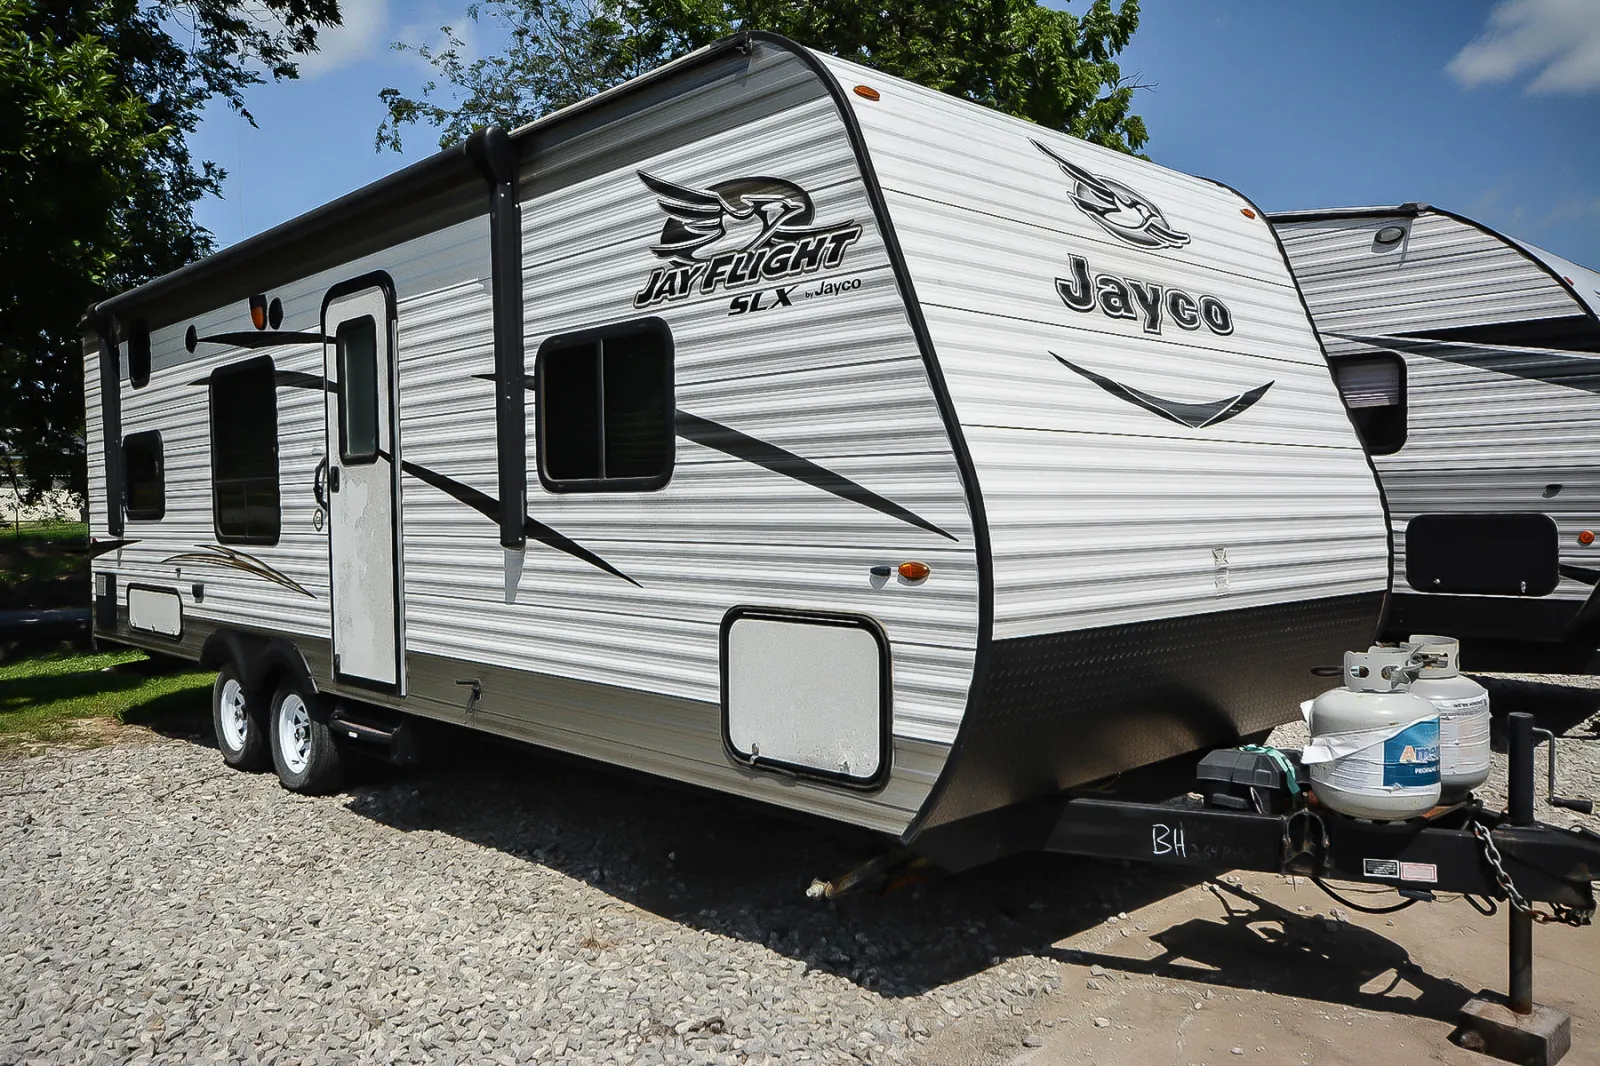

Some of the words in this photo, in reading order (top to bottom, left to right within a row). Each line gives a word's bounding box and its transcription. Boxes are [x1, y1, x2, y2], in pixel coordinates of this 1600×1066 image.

[728, 285, 800, 316] SLX
[805, 291, 814, 299] by
[814, 278, 862, 298] Jayco
[1054, 253, 1234, 336] Jayco
[1152, 821, 1187, 858] BH
